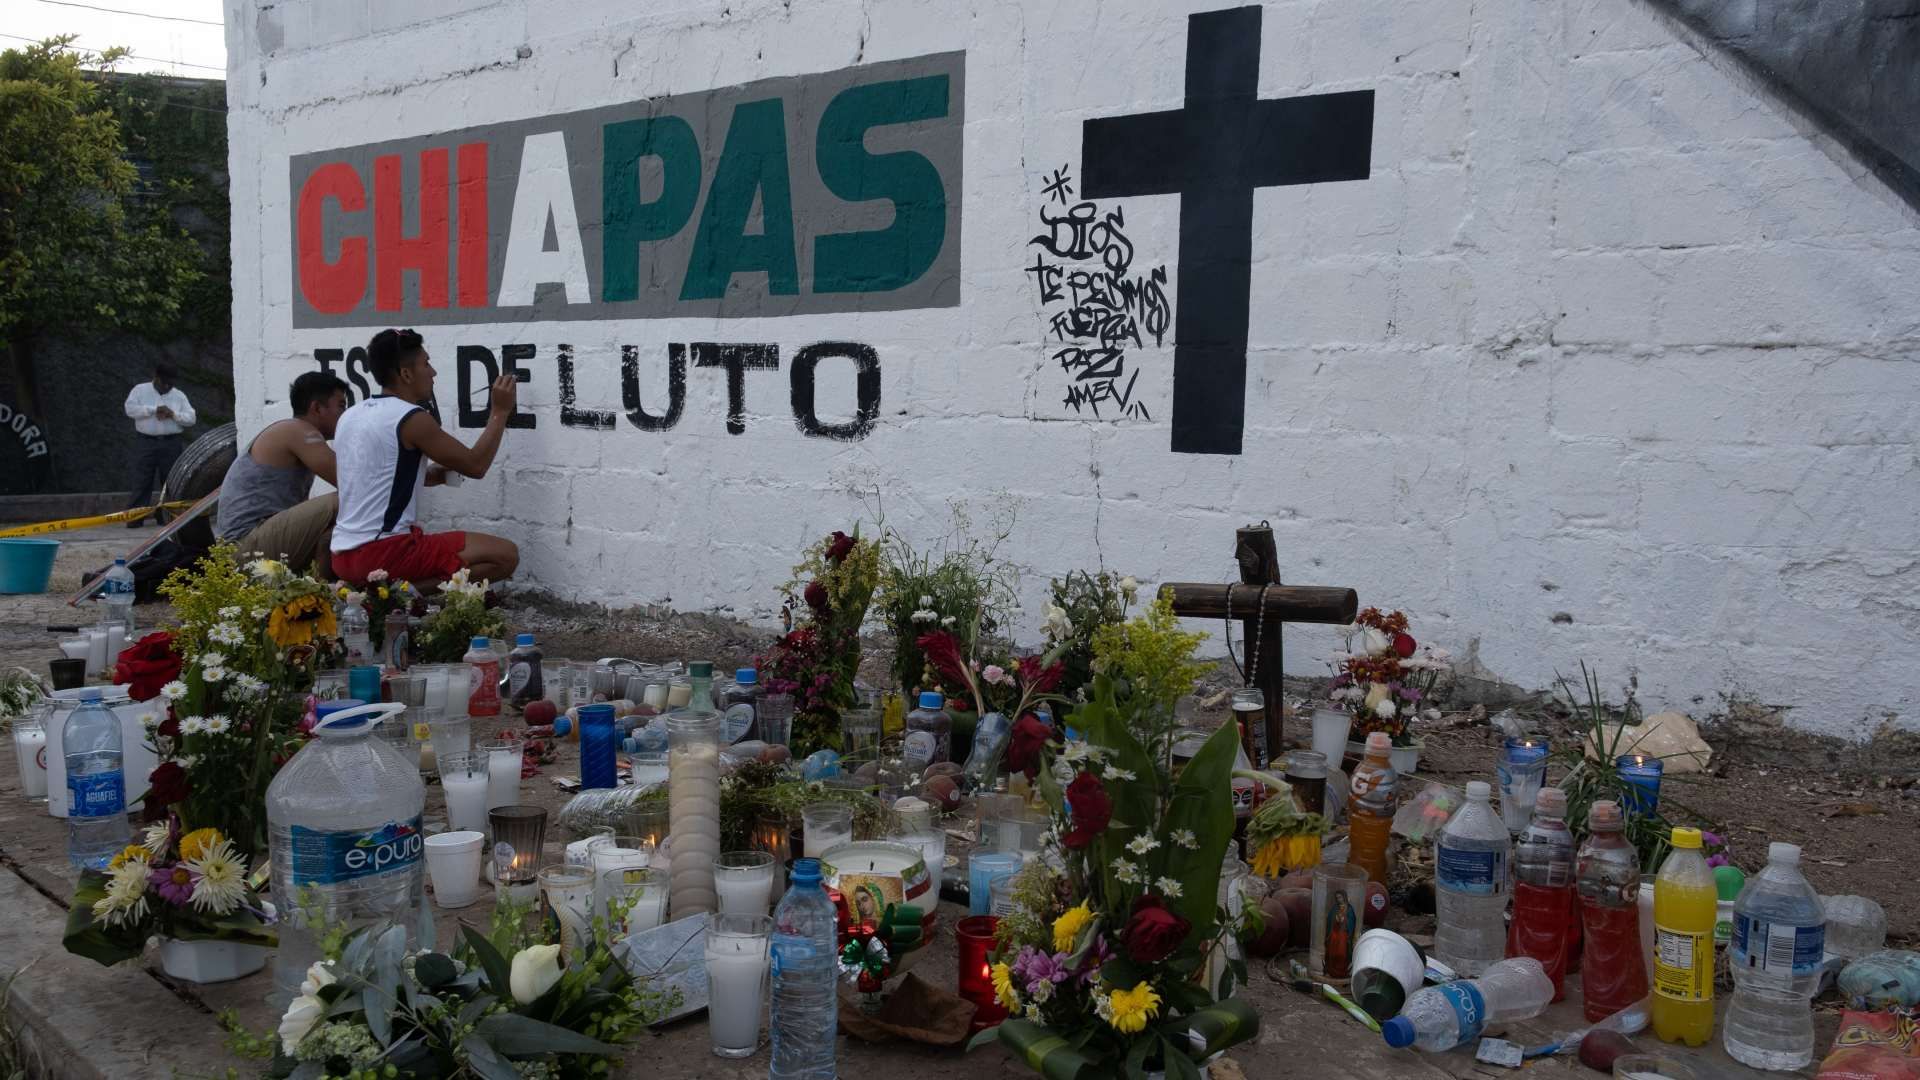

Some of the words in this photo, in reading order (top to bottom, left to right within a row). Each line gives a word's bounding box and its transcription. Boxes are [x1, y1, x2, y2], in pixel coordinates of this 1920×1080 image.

[298, 74, 950, 315] CHIAPAS
[1028, 202, 1133, 270] DIOS
[457, 344, 536, 429] DE
[556, 341, 882, 443] LUTO
[1052, 347, 1124, 381] PAZ
[1063, 368, 1139, 418] AMEN
